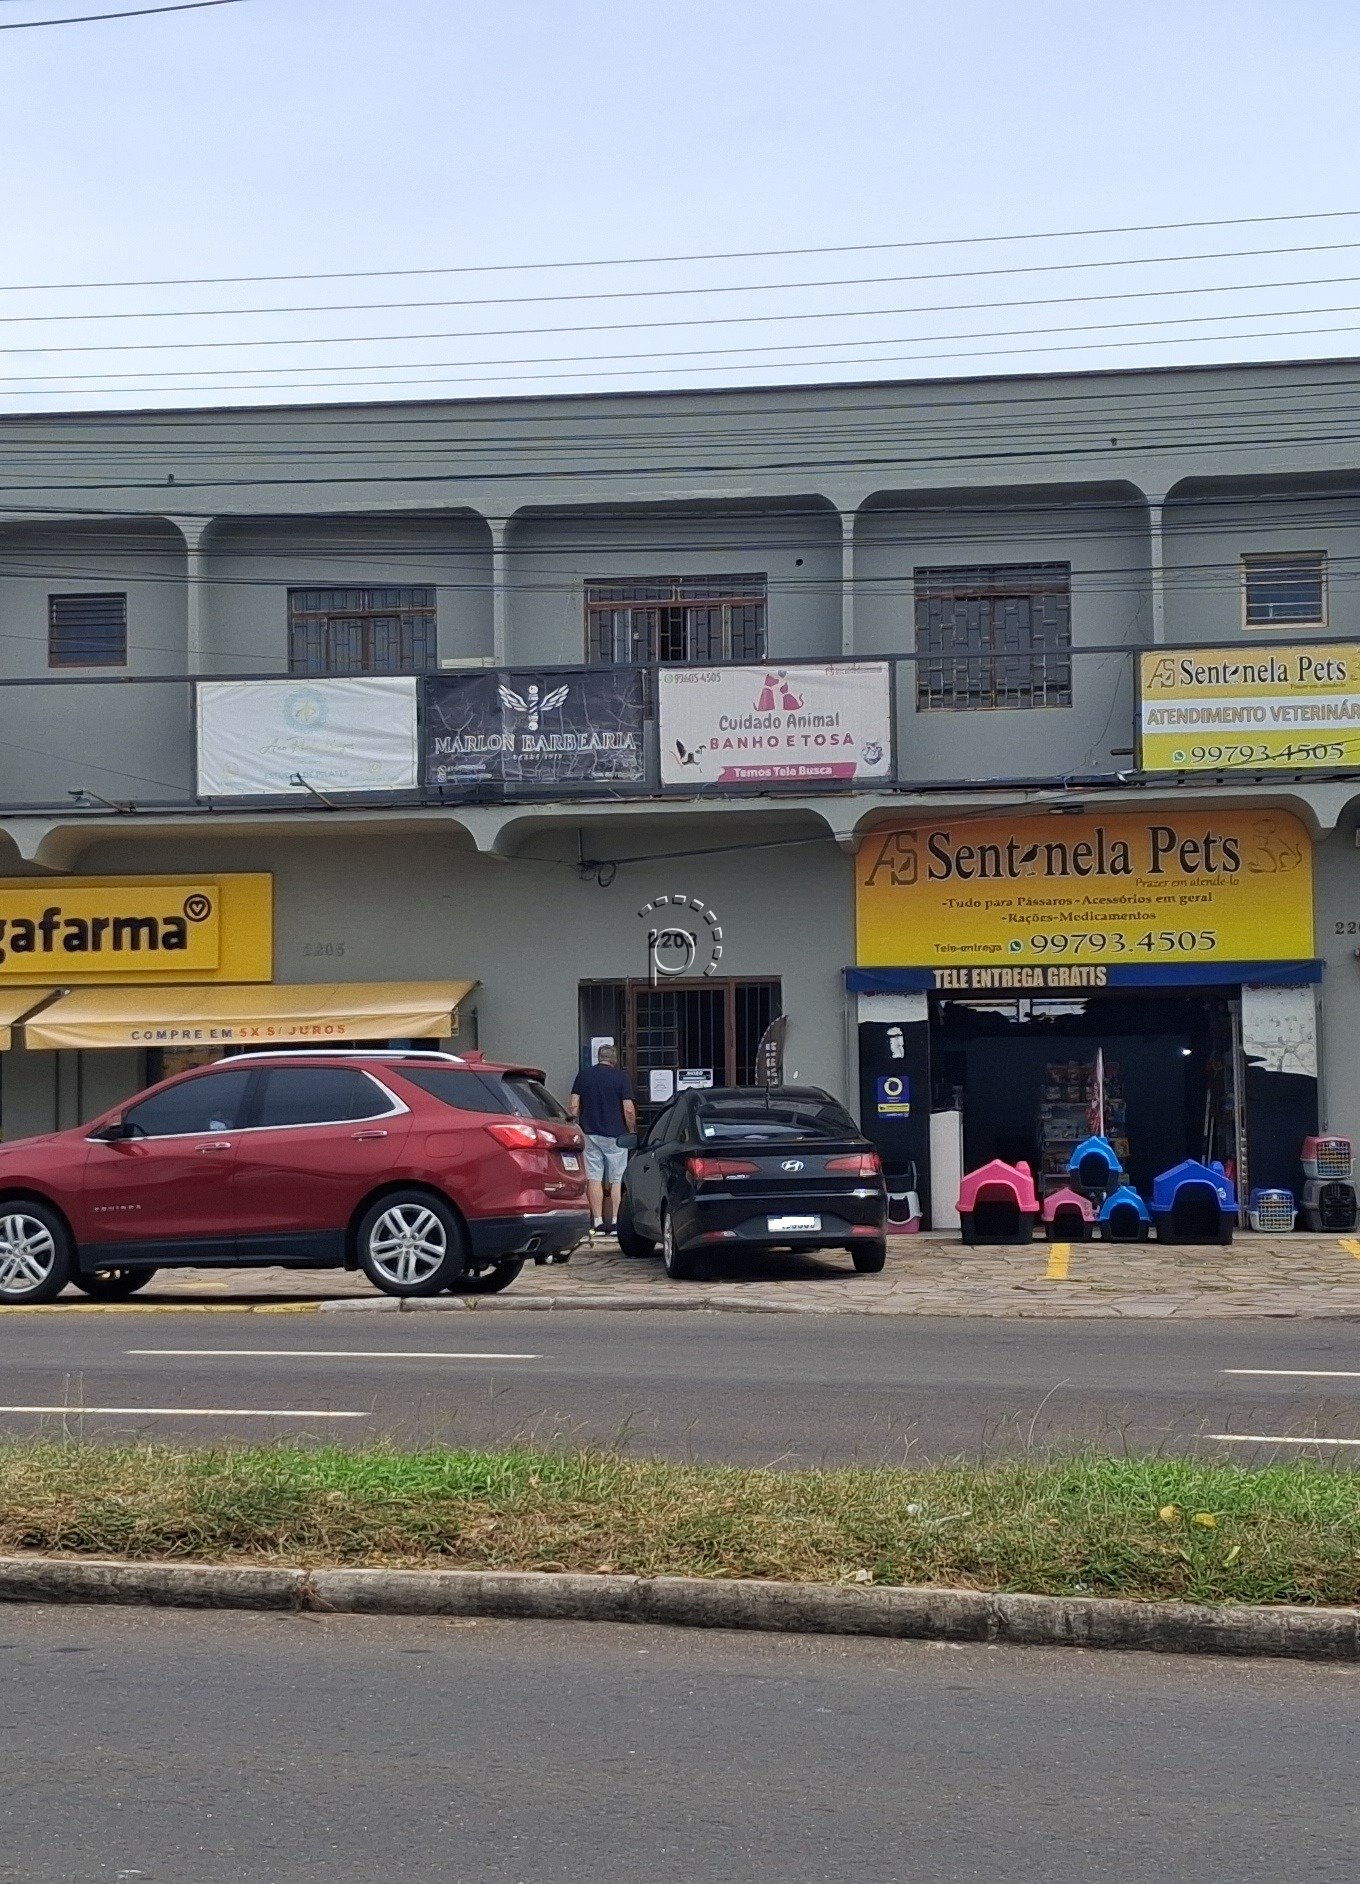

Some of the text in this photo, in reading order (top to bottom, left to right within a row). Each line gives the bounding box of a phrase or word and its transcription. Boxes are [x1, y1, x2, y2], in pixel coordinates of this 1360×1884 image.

[719, 712, 839, 731] Cuidado Animal
[1147, 705, 1266, 725] ATENDIMENTO
[435, 732, 636, 754] MARLON BARBEARIA
[710, 733, 854, 750] BANHO E TOSA
[1191, 743, 1344, 763] 99793.4505
[733, 767, 771, 779] Temos
[799, 765, 832, 776] Busca
[984, 899, 1013, 910] para
[1156, 895, 1176, 903] em
[1179, 892, 1213, 906] geral
[1030, 930, 1216, 954] 99793.4505
[933, 965, 1107, 990] TELE ENTREGA GRÁTIS
[132, 1029, 202, 1041] COMPRE
[210, 1028, 233, 1039] EM
[240, 1027, 260, 1038] 5X
[289, 1024, 346, 1036] JUROS
